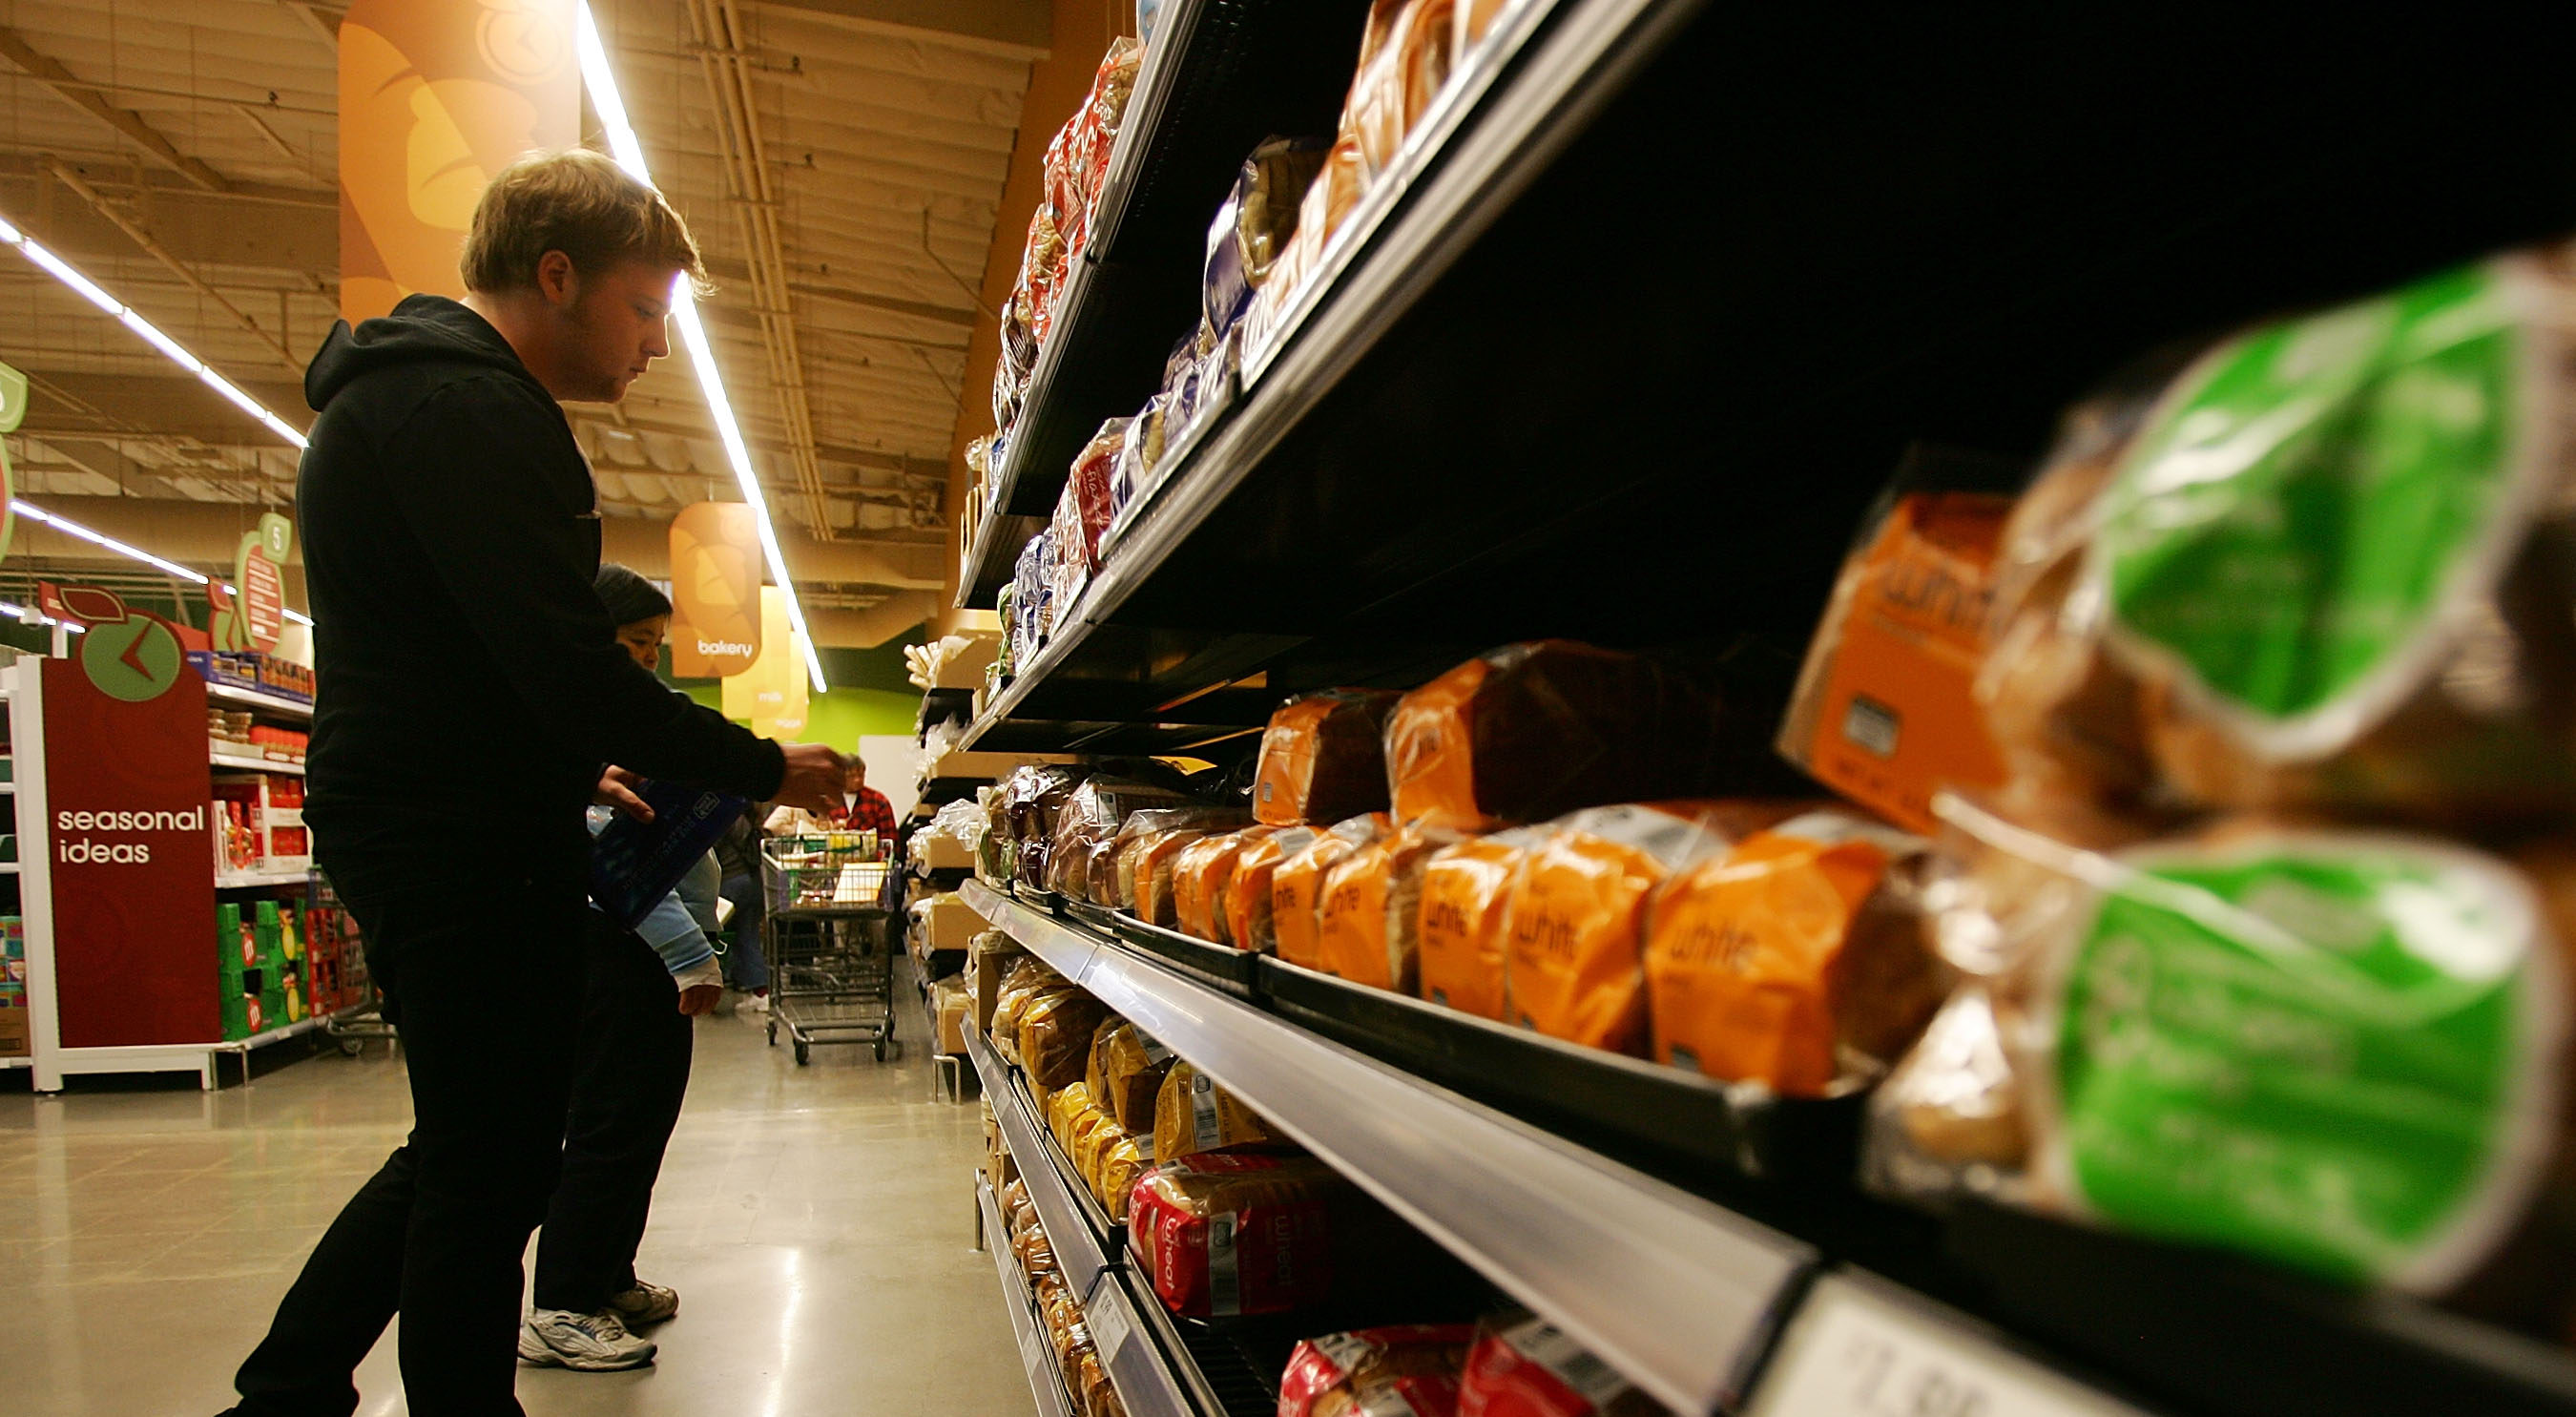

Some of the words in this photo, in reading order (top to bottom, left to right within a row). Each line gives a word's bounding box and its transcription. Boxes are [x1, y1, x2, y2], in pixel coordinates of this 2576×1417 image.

[697, 639, 752, 658] bakery
[57, 805, 204, 831] seasonal
[59, 838, 150, 864] ideas
[1163, 1217, 1177, 1291] wheat
